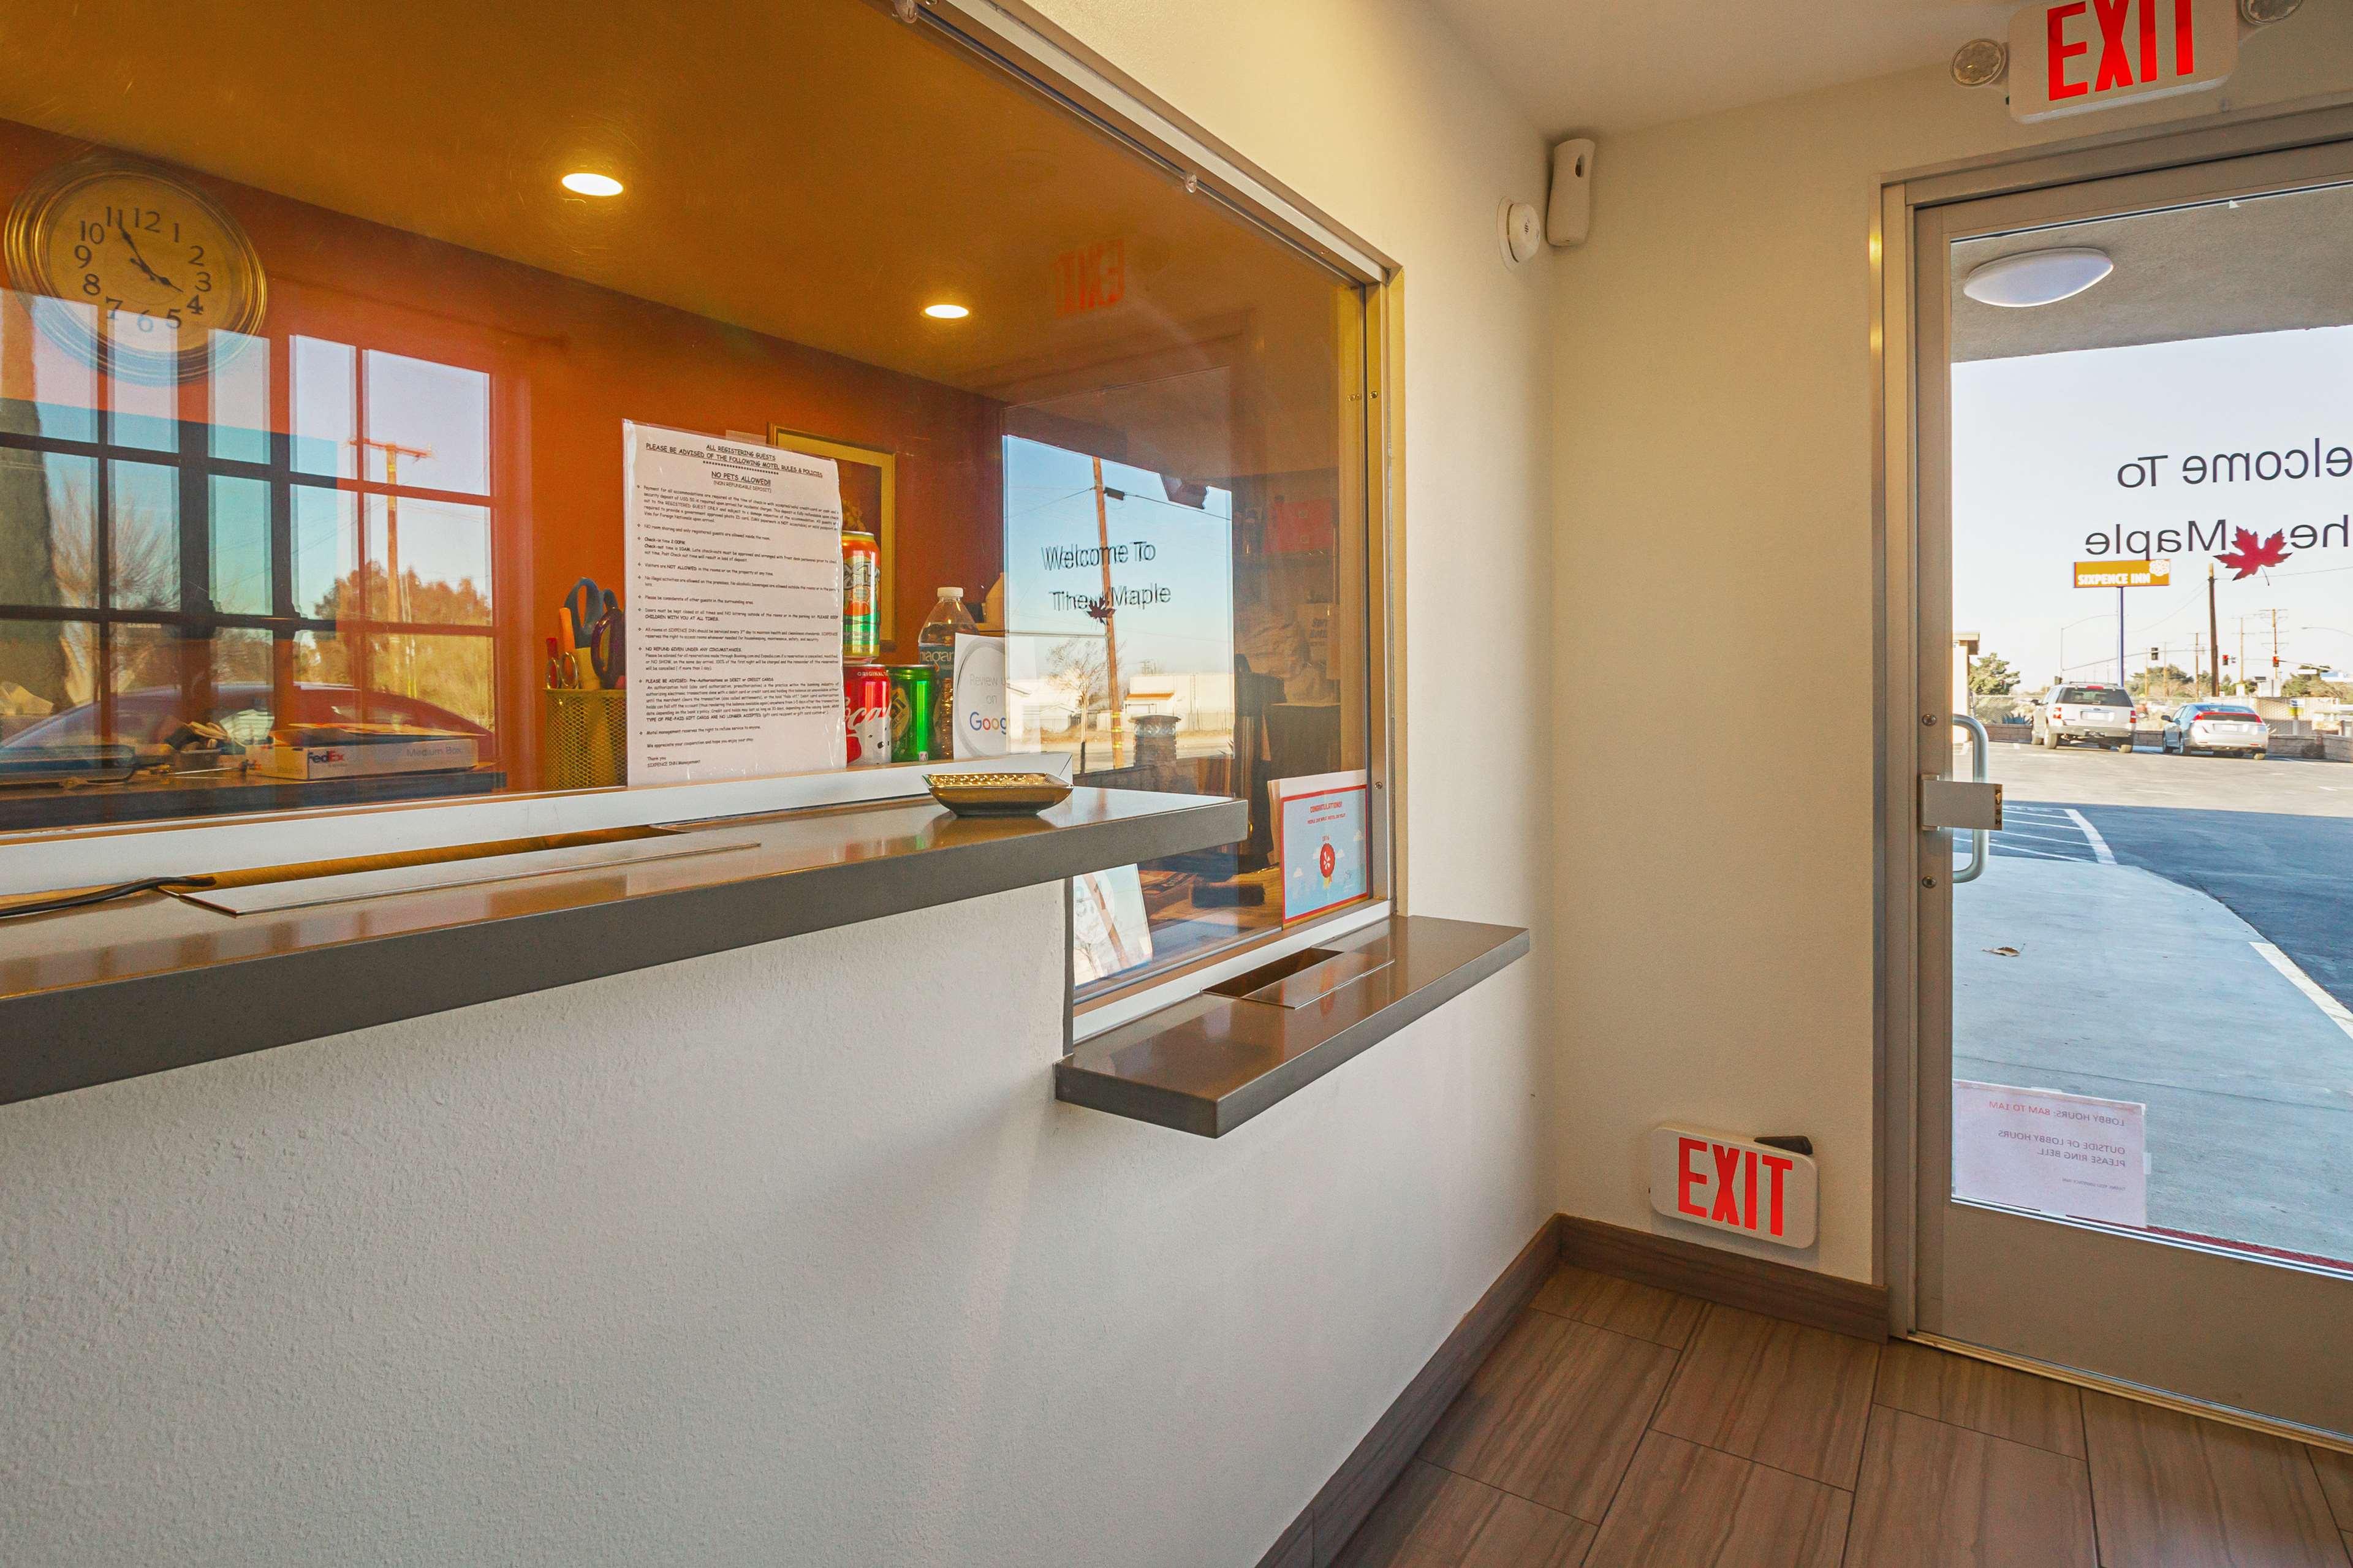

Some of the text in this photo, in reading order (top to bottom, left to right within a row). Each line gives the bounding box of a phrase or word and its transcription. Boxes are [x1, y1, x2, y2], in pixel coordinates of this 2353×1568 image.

[2047, 0, 2194, 101] EXIT
[134, 206, 161, 233] 12
[80, 221, 105, 244] 10
[173, 223, 180, 243] 1
[74, 245, 93, 268] 9
[188, 245, 205, 267] 2
[83, 273, 101, 296] 8
[194, 272, 212, 292] 3
[105, 296, 123, 321] 7
[186, 294, 204, 315] 4
[165, 308, 183, 329] 5
[646, 443, 667, 452] PLEASE
[679, 449, 704, 458] ADVISED
[729, 456, 760, 467] FOLLOWING
[718, 446, 754, 456] REGISTERING
[1041, 541, 1156, 570] Welcome To
[2077, 573, 2150, 585] SIXPENCE INN
[1049, 583, 1171, 611] The Maple
[920, 651, 954, 672] niagar
[970, 673, 999, 686] Review
[969, 711, 1006, 735] Goog
[308, 749, 344, 764] FedEx
[406, 748, 442, 757] Medium
[1678, 1137, 1793, 1237] EXIT
